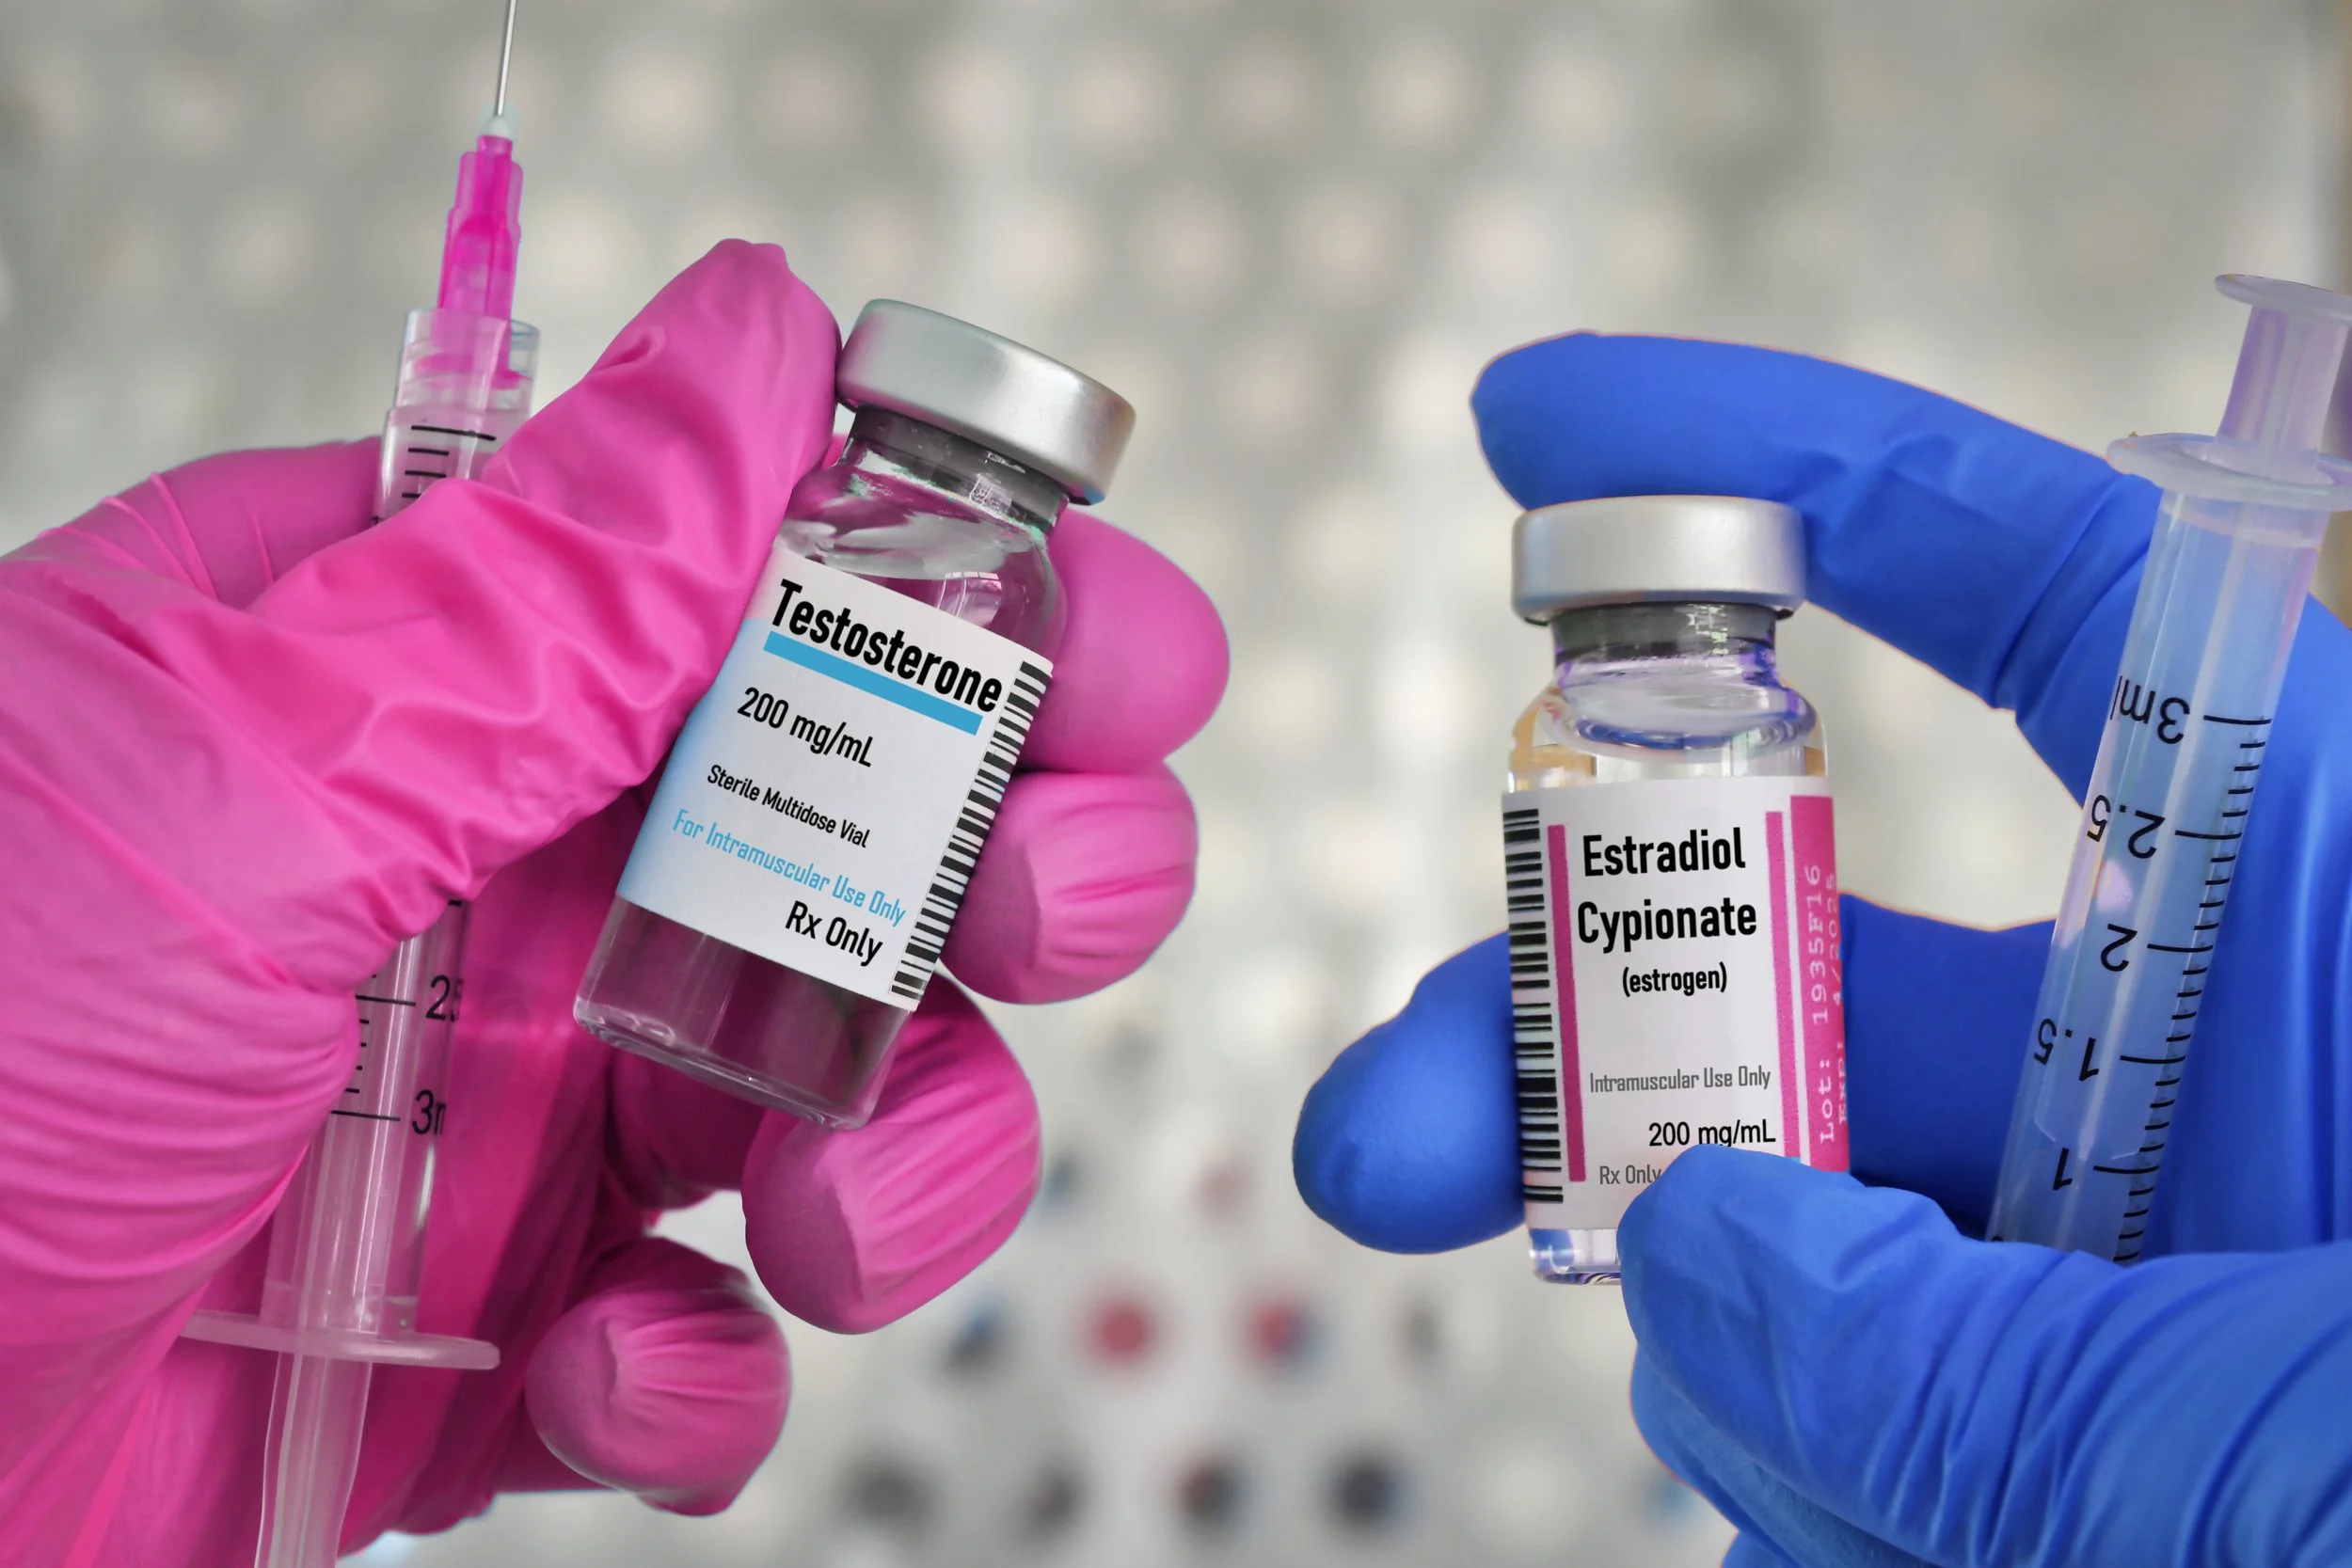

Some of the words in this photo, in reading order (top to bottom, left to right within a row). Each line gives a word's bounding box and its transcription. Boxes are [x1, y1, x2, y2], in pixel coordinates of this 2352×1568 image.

[771, 578, 1003, 713] Testosterone
[737, 687, 788, 729] 200
[789, 713, 872, 768] mg/mL
[707, 764, 759, 802] Sterile
[761, 786, 837, 833] Multidose
[839, 819, 871, 848] Vial
[673, 809, 705, 838] For
[705, 823, 831, 892] Intramuscular
[833, 875, 866, 907] Use
[868, 891, 907, 927] Only
[1582, 826, 1746, 877] Estradiol
[785, 900, 822, 939] Rx
[824, 916, 883, 967] Only
[1577, 896, 1757, 955] Cypionate
[1804, 864, 1829, 1025] 1935F16
[1622, 961, 1727, 998] (estrogen)
[1590, 1069, 1699, 1093] Intramuscular
[1703, 1067, 1733, 1088] Use
[1738, 1065, 1772, 1089] Only
[1818, 1059, 1836, 1146] Lot:
[1648, 1121, 1691, 1147] 200
[1697, 1118, 1777, 1148] mg/mL
[1598, 1165, 1620, 1185] Rx
